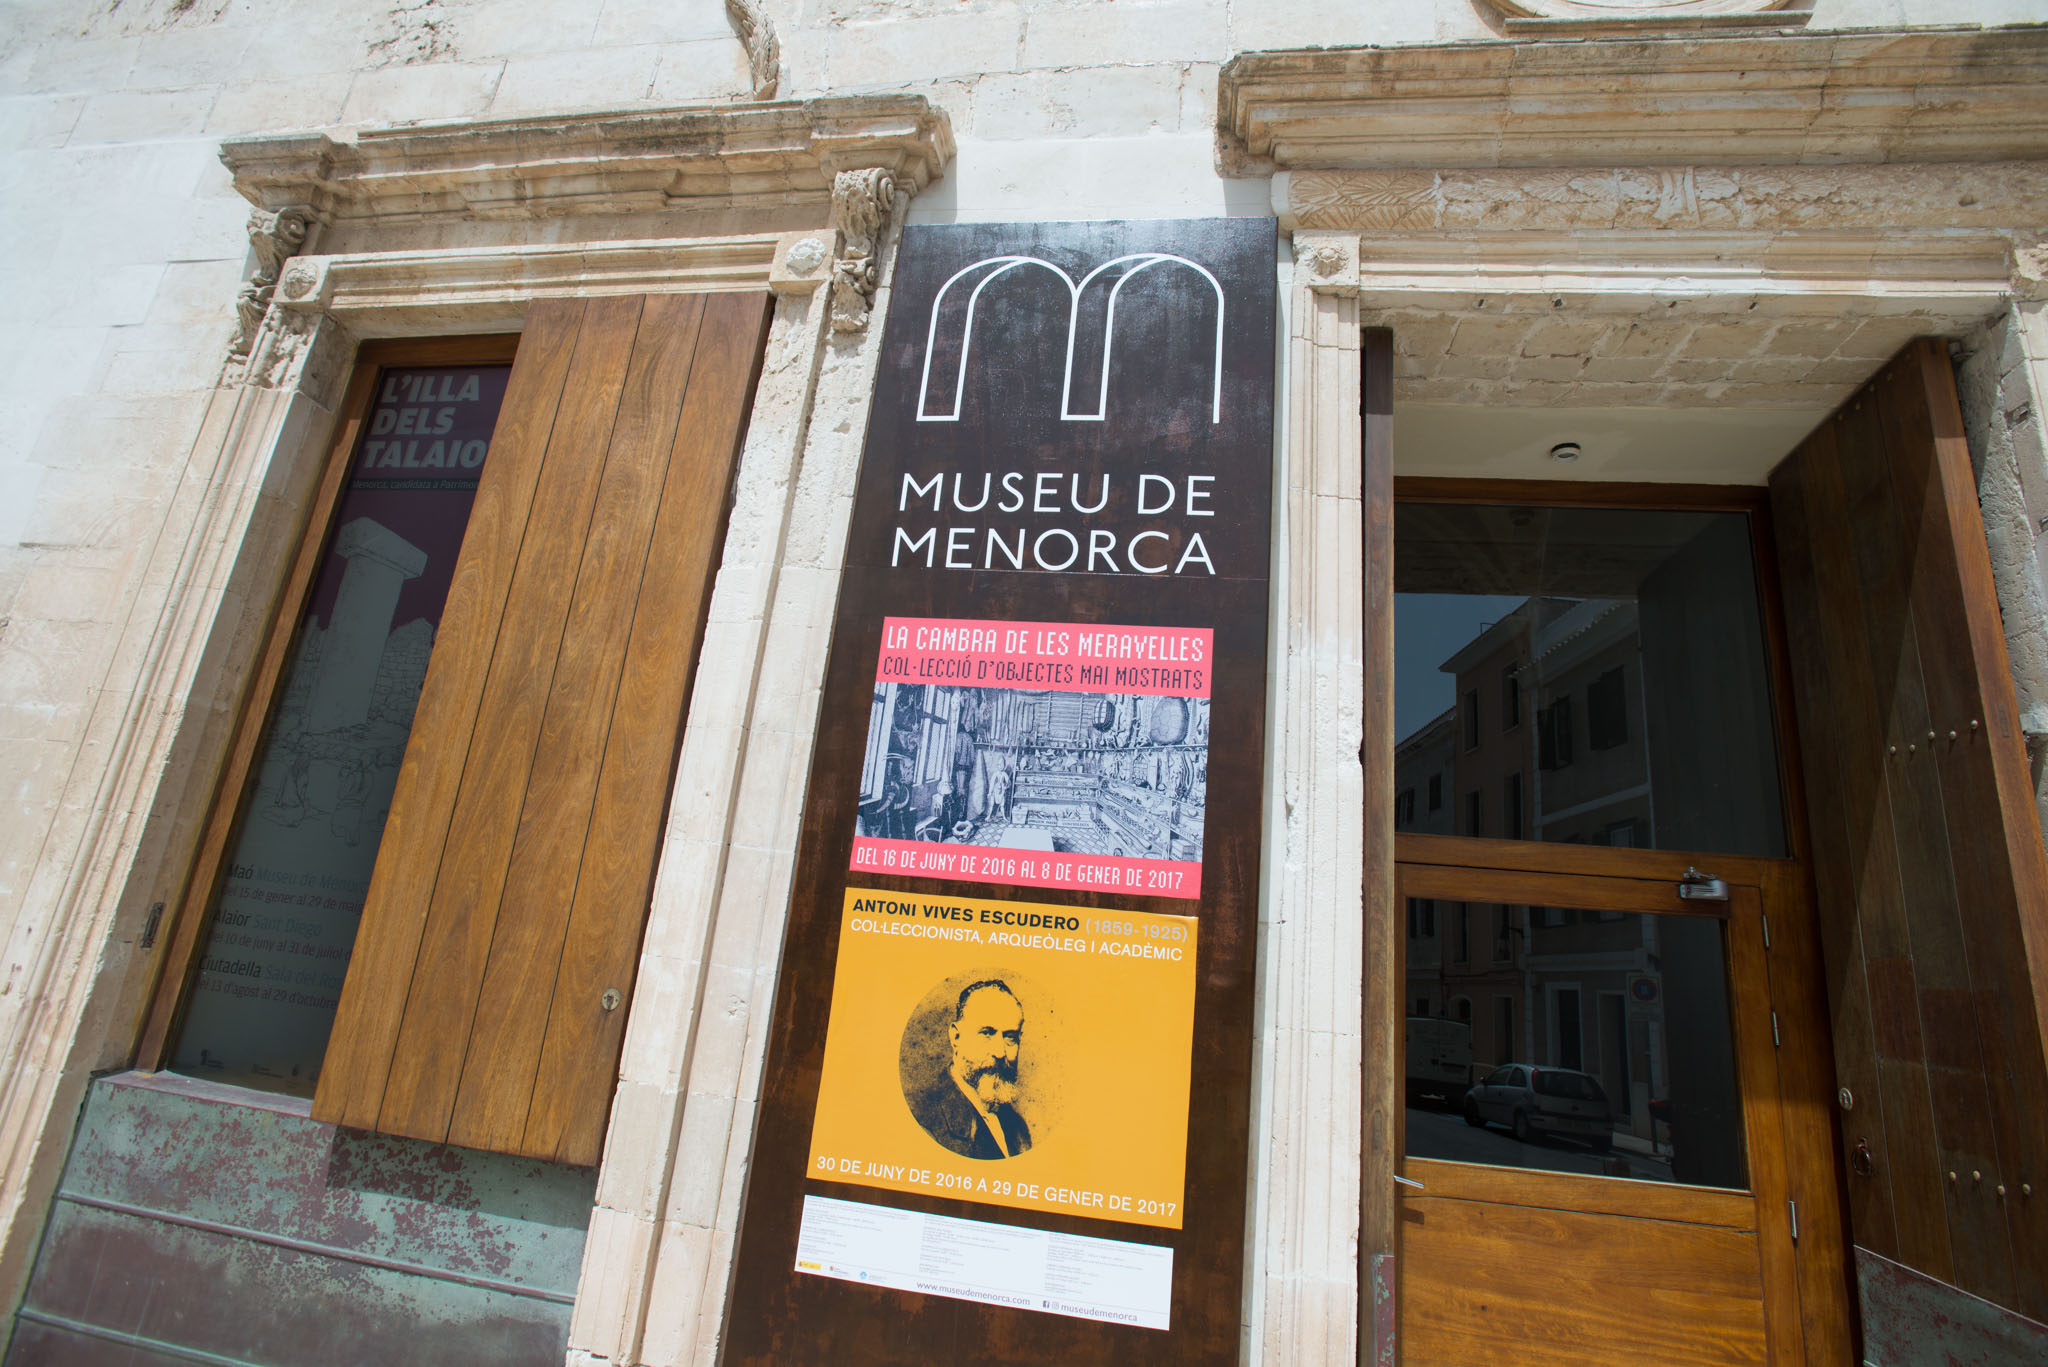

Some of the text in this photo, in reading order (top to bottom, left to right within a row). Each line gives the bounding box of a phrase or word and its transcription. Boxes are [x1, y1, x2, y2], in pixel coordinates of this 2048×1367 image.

[382, 375, 480, 402] L'ILLA
[370, 407, 456, 435] DELS
[363, 440, 487, 468] TALAIO
[899, 472, 1216, 516] MUSEU DE
[892, 528, 1216, 575] MENORCA
[886, 625, 1203, 662] LA CAMBRA DE LES MERAVELLES
[978, 660, 1073, 684] D'OBJECTES
[1080, 667, 1109, 685] MAI
[1115, 668, 1203, 690] MOSTRATS
[856, 847, 1183, 889] DEL 16 DE JUNY DE 2016 AL 8 DE GENER DE 2017
[252, 888, 264, 900] de
[265, 891, 294, 904] gener
[297, 894, 307, 905] al
[323, 897, 337, 910] de
[213, 909, 251, 927] Alaior
[852, 898, 1188, 943] ANTONI VIVES ESCUDERO (1859-1925)
[239, 933, 252, 947] de
[253, 937, 275, 952] juny
[276, 940, 287, 951] al
[302, 944, 315, 956] de
[988, 930, 1087, 953] ARQUEÒLEG
[1090, 940, 1095, 954] I
[1099, 940, 1183, 962] ACADÈMIC
[199, 955, 261, 978] Ciutadella
[261, 986, 272, 999] al
[817, 1156, 1177, 1218] 30 DE JUNY DE 2016 A 29 DE GENER DE 2017
[917, 1281, 1030, 1306] www.museudemenorca.com
[1061, 1304, 1138, 1322] museudemenorca
